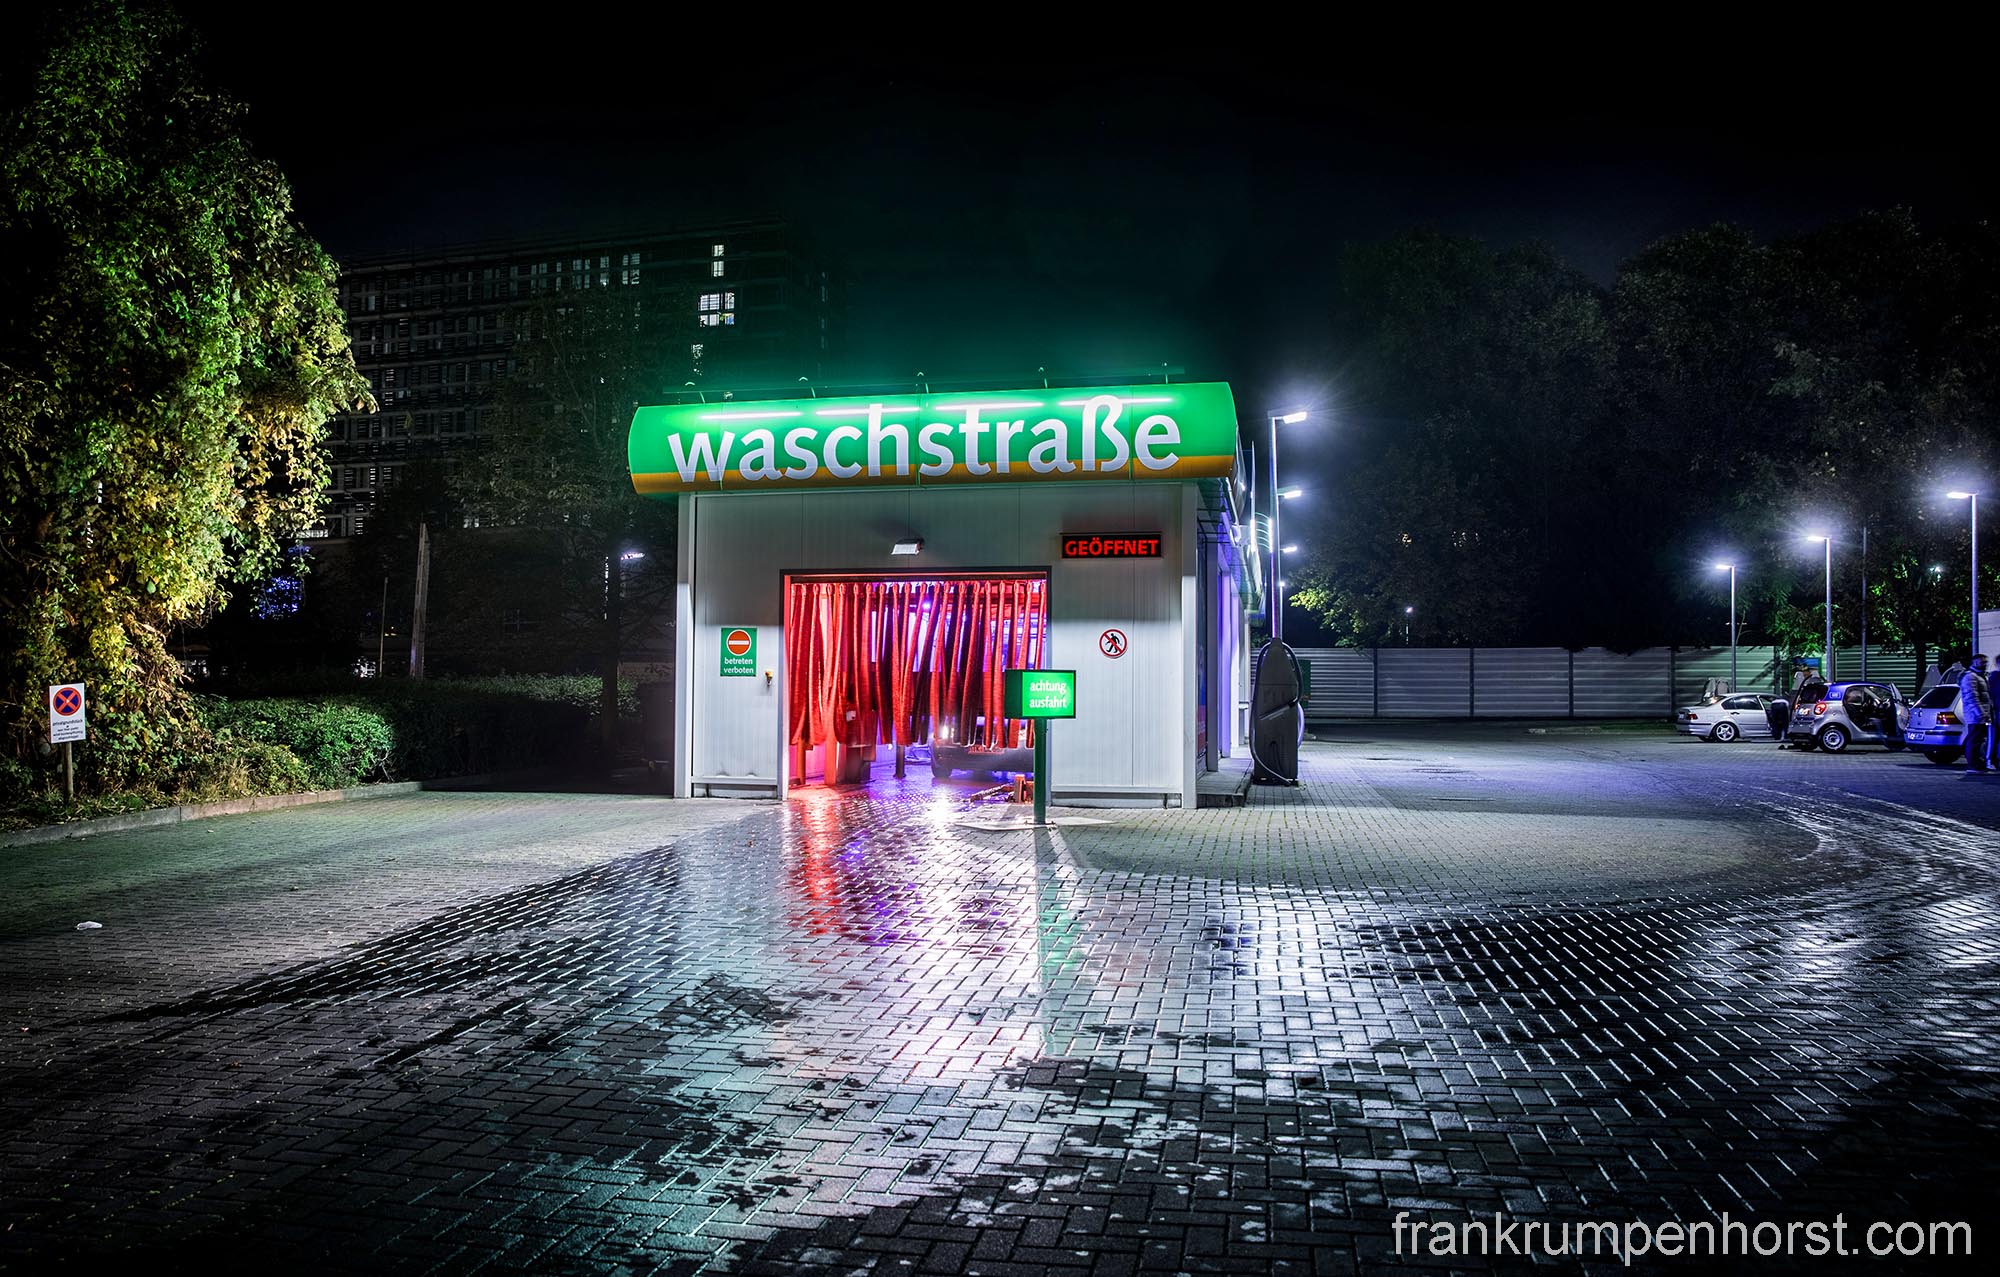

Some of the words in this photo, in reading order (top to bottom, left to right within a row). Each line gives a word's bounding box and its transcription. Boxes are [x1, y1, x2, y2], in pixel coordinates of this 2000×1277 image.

[667, 395, 1181, 482] waschstraße
[1065, 537, 1158, 555] GEÖFFNET
[724, 657, 753, 665] betreten
[723, 666, 754, 674] verboten
[1030, 680, 1067, 695] achtung
[1029, 695, 1067, 708] ausfahrt
